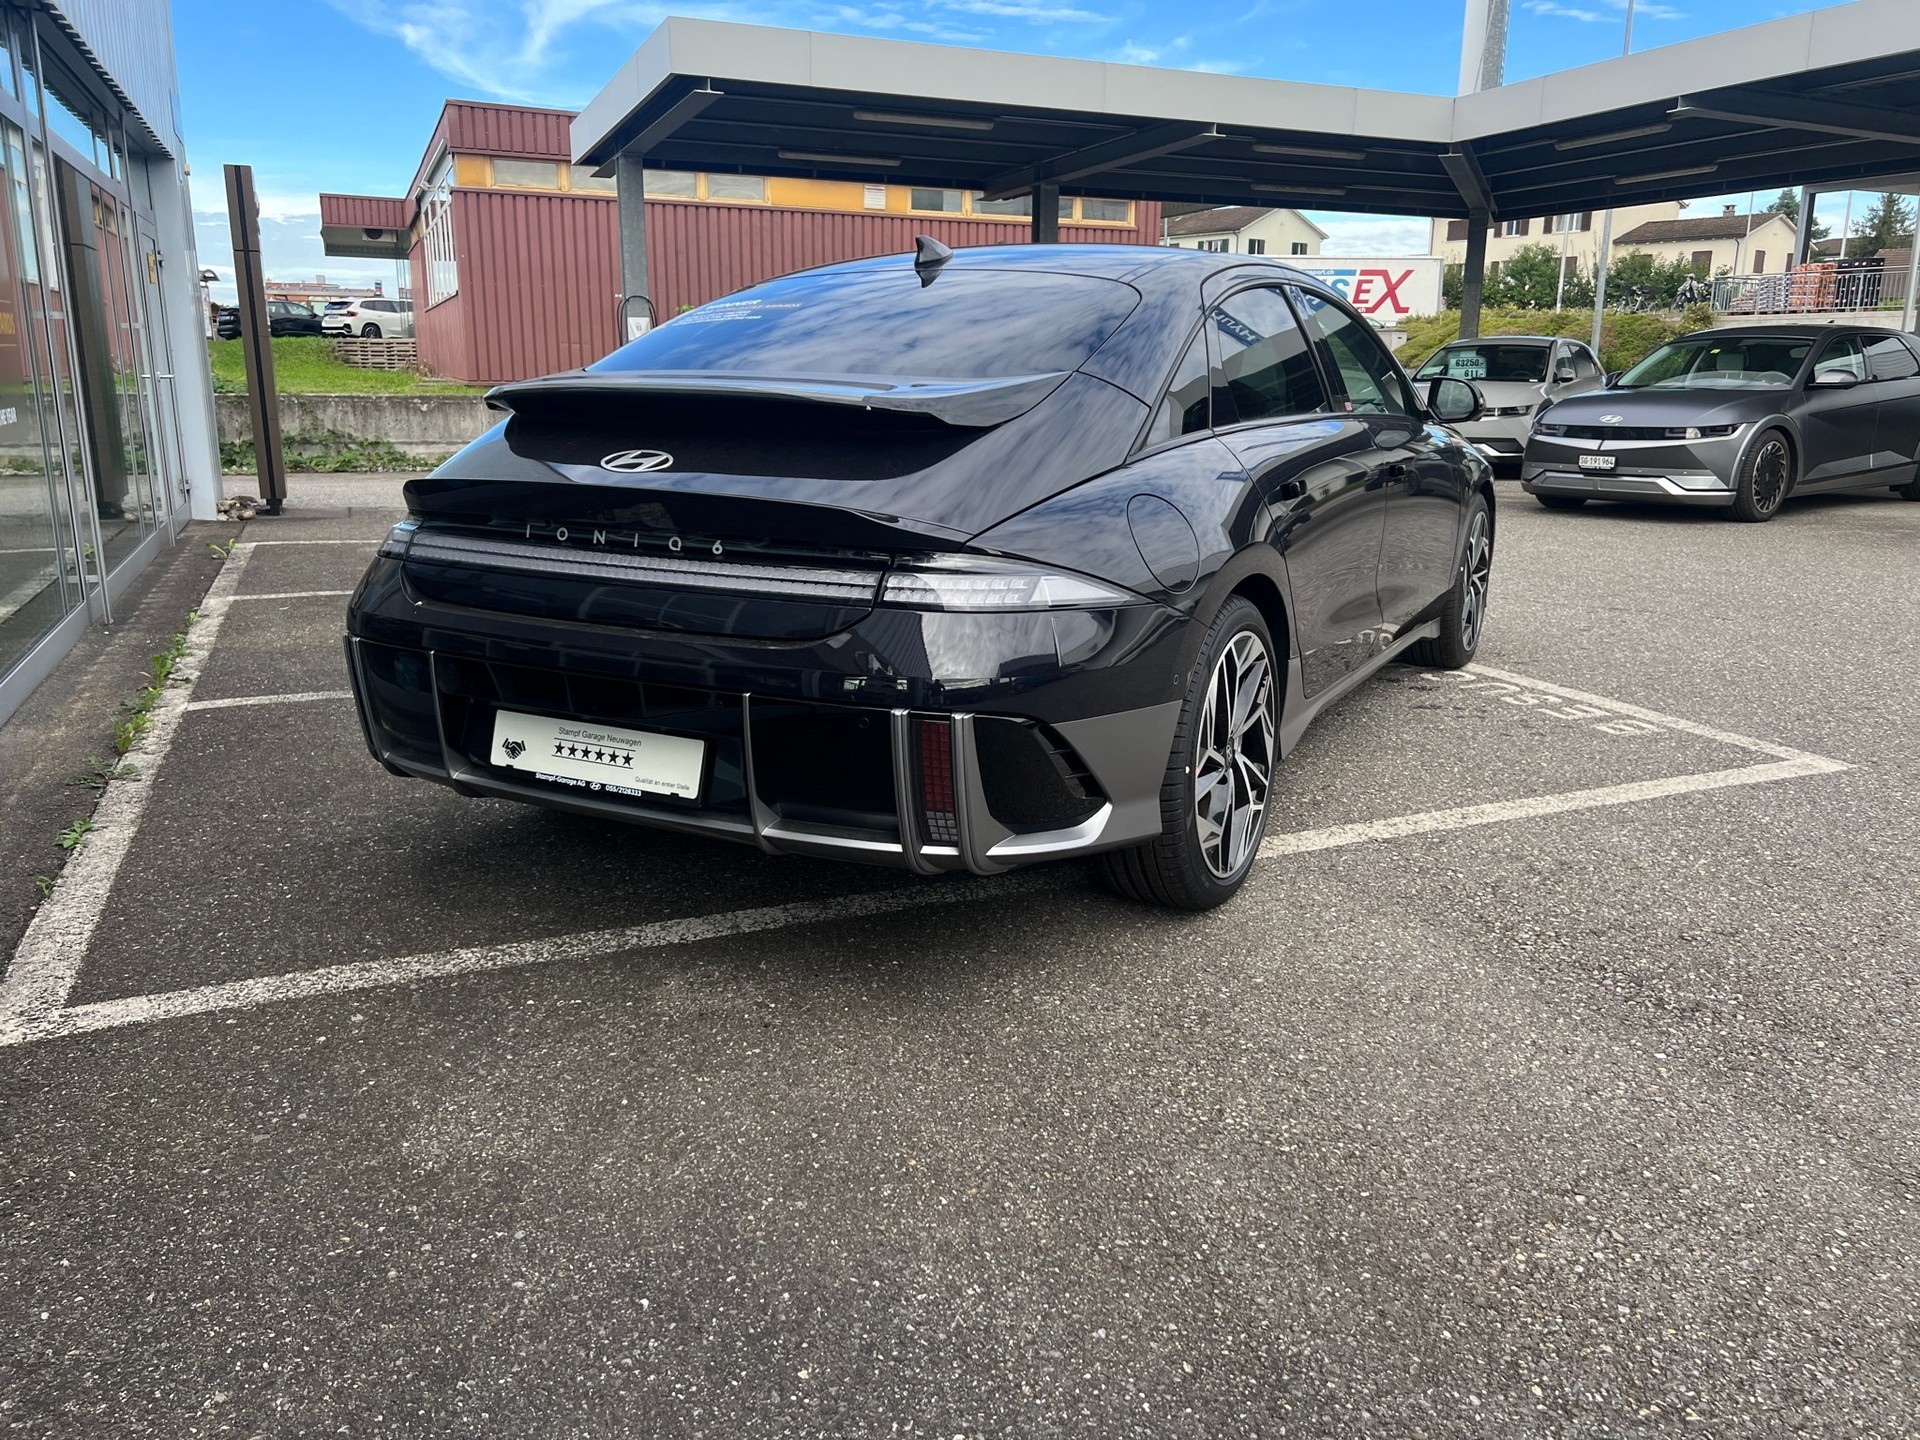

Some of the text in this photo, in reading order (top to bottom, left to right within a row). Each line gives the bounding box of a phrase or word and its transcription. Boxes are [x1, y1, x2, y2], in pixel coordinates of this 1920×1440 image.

[526, 524, 724, 555] IONIQ 6
[558, 726, 642, 747] Stampf Garage Neuwagen
[535, 772, 577, 786] Stampf-Garage
